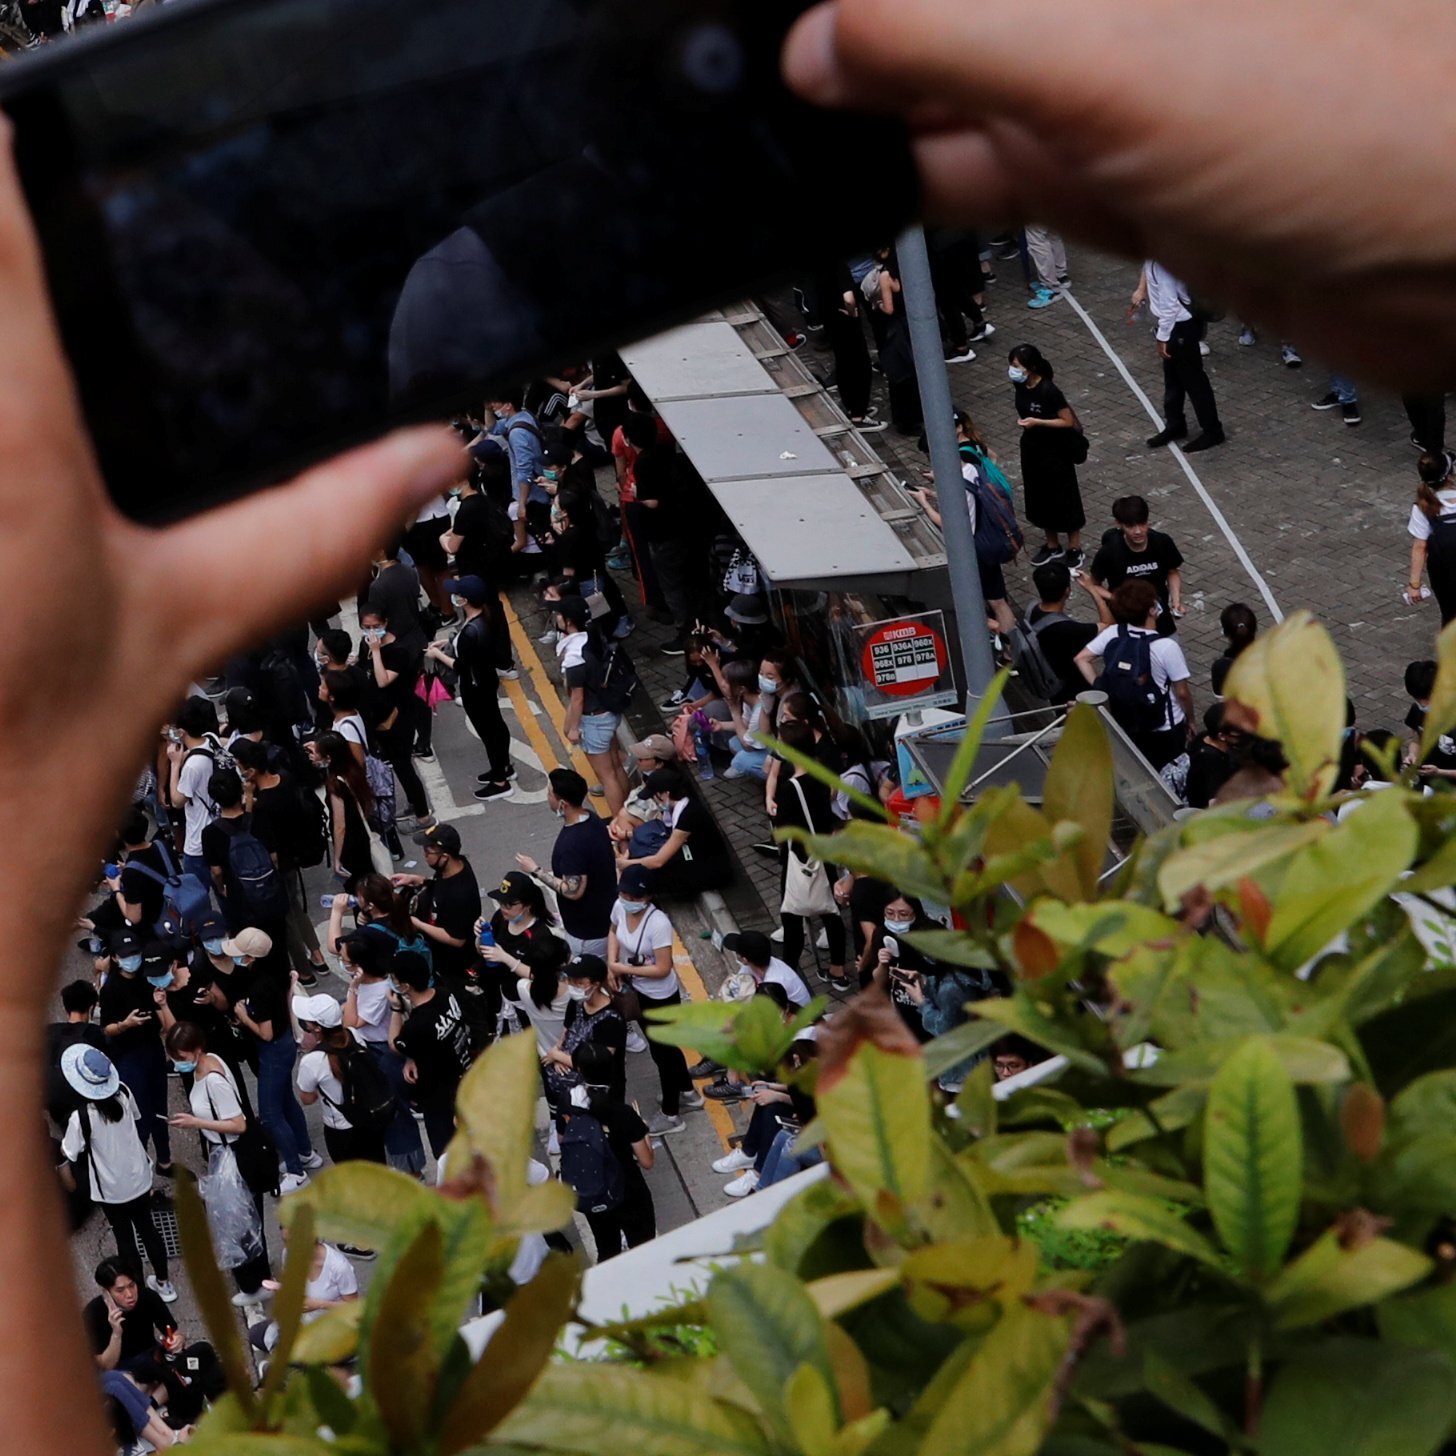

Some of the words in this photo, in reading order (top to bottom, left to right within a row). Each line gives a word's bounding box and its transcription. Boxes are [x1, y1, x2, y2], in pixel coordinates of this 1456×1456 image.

[892, 627, 917, 639] KMB
[874, 644, 889, 655] 936
[893, 641, 913, 651] 936A
[897, 655, 913, 665] 978
[915, 651, 936, 661] 978A
